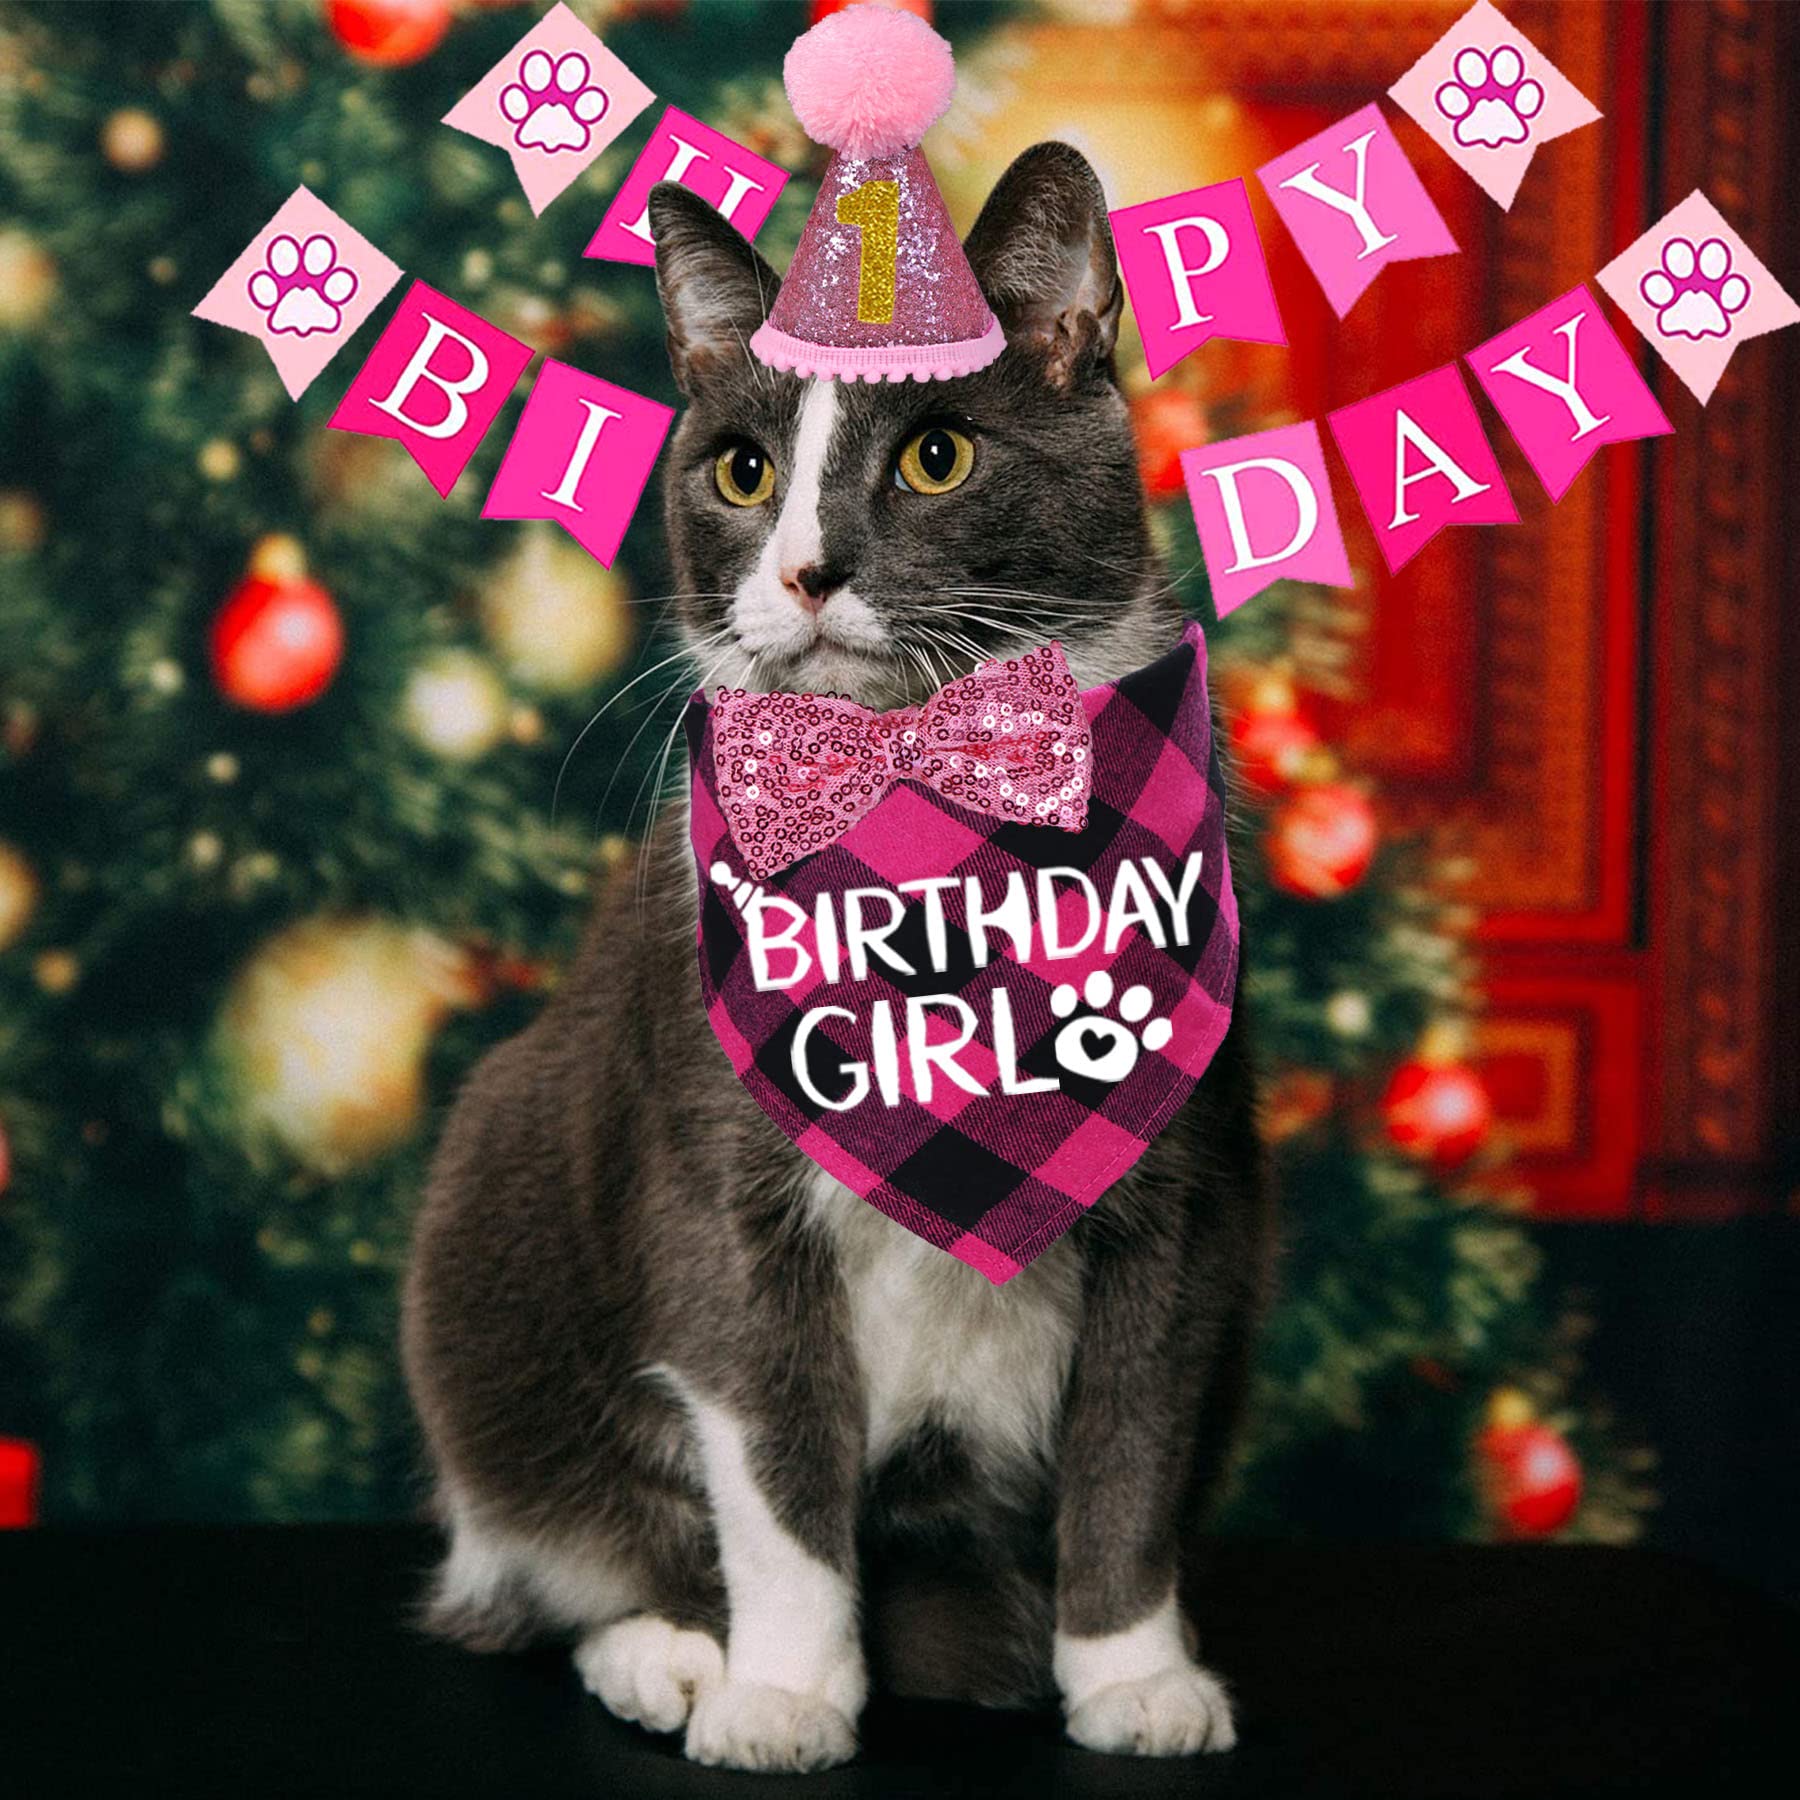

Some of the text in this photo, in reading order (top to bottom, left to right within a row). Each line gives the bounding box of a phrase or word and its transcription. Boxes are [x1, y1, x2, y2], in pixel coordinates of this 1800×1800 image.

[836, 180, 899, 325] 1
[745, 851, 1203, 992] BIRTHDAY
[790, 987, 1060, 1111] GIRL
